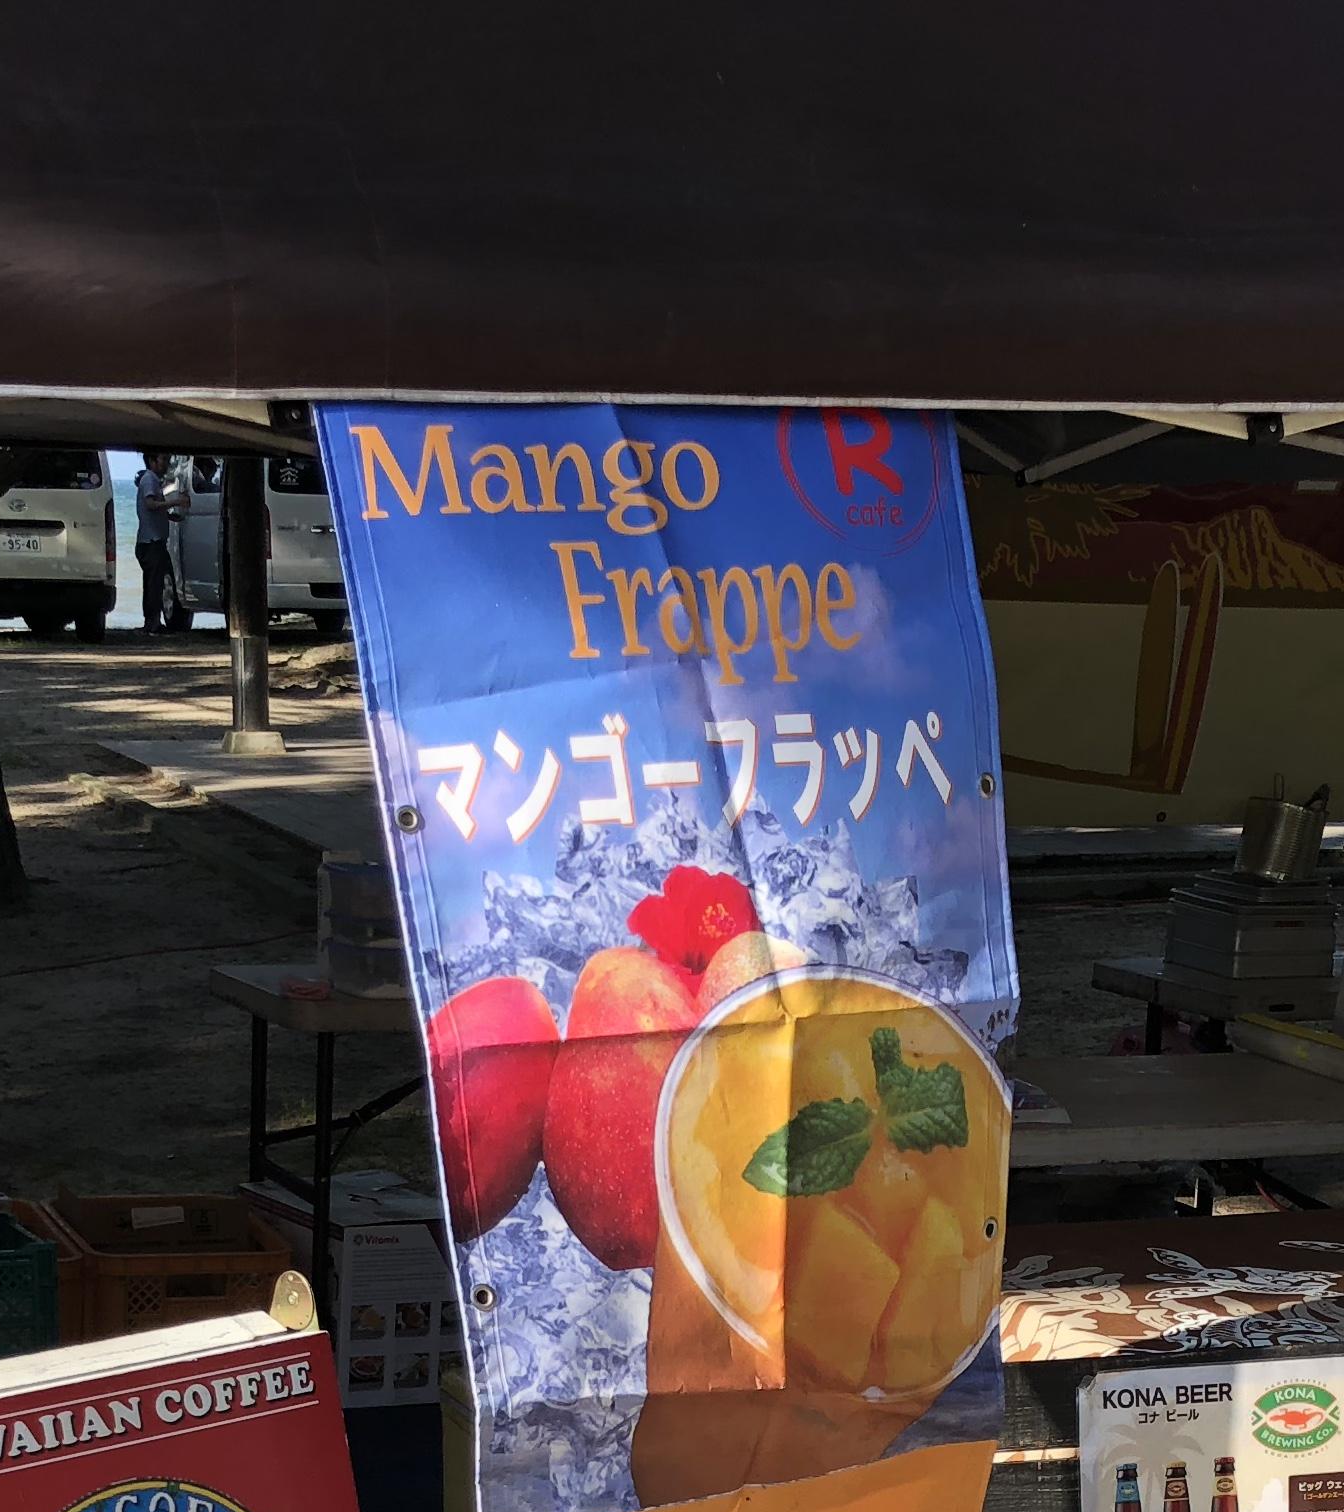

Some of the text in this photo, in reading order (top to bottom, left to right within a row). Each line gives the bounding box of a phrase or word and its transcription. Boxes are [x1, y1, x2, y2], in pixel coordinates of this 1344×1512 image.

[820, 406, 904, 496] R
[349, 423, 721, 536] Mango
[847, 497, 904, 528] cafe
[550, 540, 862, 686] Frappe
[416, 709, 954, 845] マンゴーフラッペ
[155, 1361, 316, 1424] COFFEE
[1102, 1382, 1233, 1410] KONA BEER
[1137, 1407, 1201, 1425] コナ ビール
[1274, 1387, 1317, 1404] KONA
[1260, 1427, 1333, 1449] BREWING CO.
